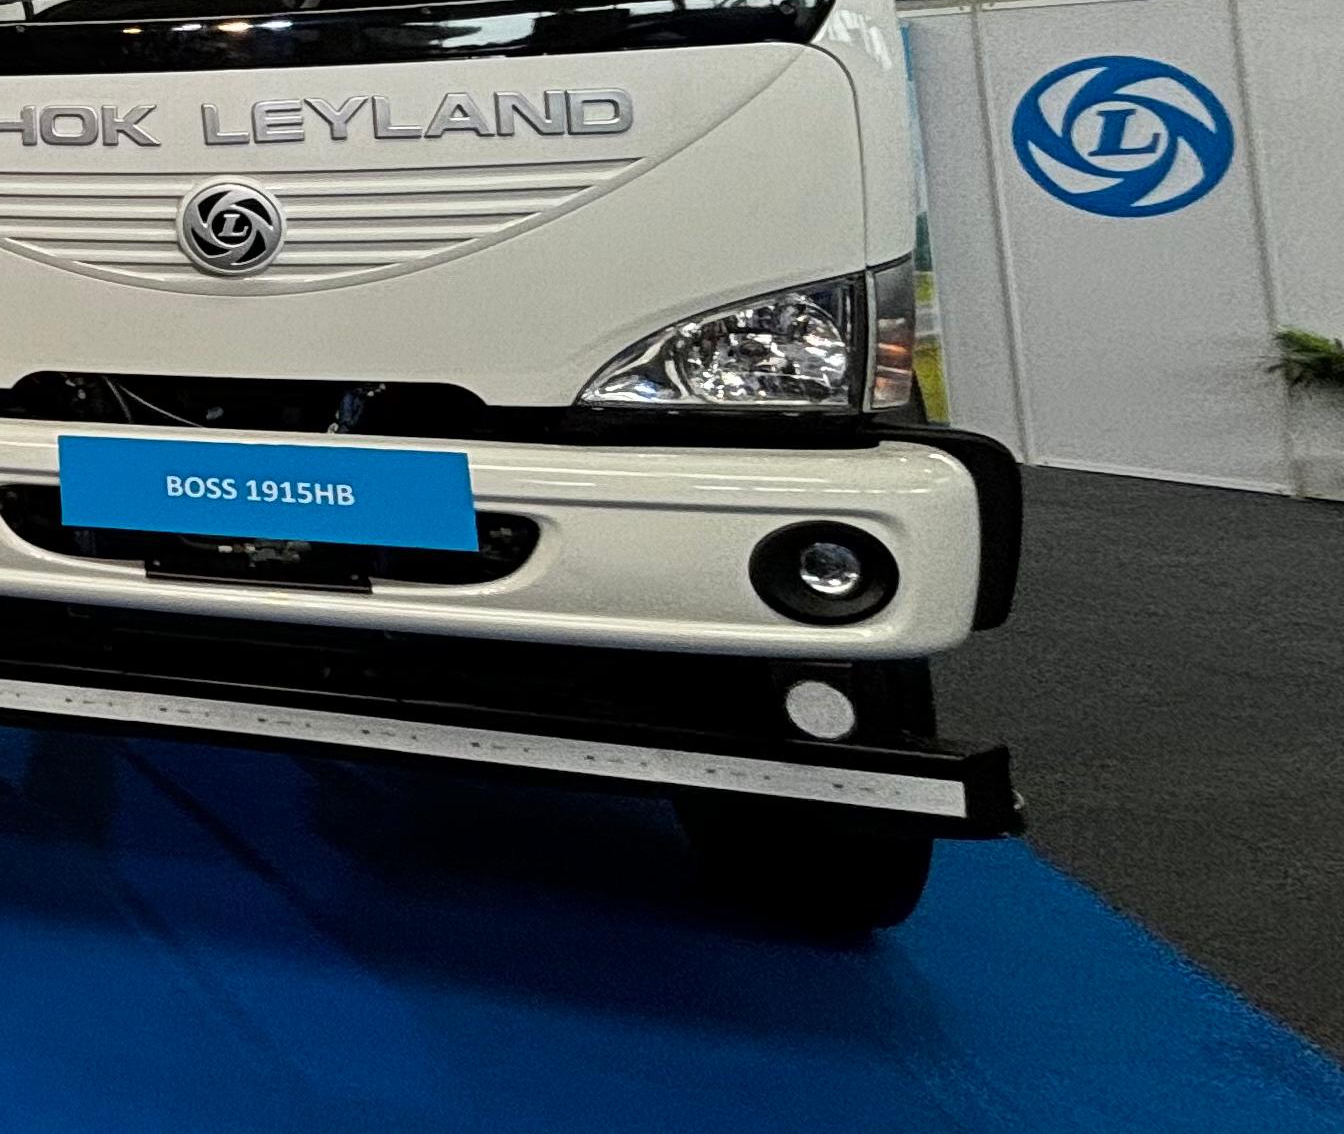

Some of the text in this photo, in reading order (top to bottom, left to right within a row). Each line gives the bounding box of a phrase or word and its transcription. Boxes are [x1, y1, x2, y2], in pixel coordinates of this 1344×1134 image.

[200, 86, 635, 146] LEYLAND
[1087, 108, 1161, 156] L
[165, 474, 356, 506] BOSS 1915HB
